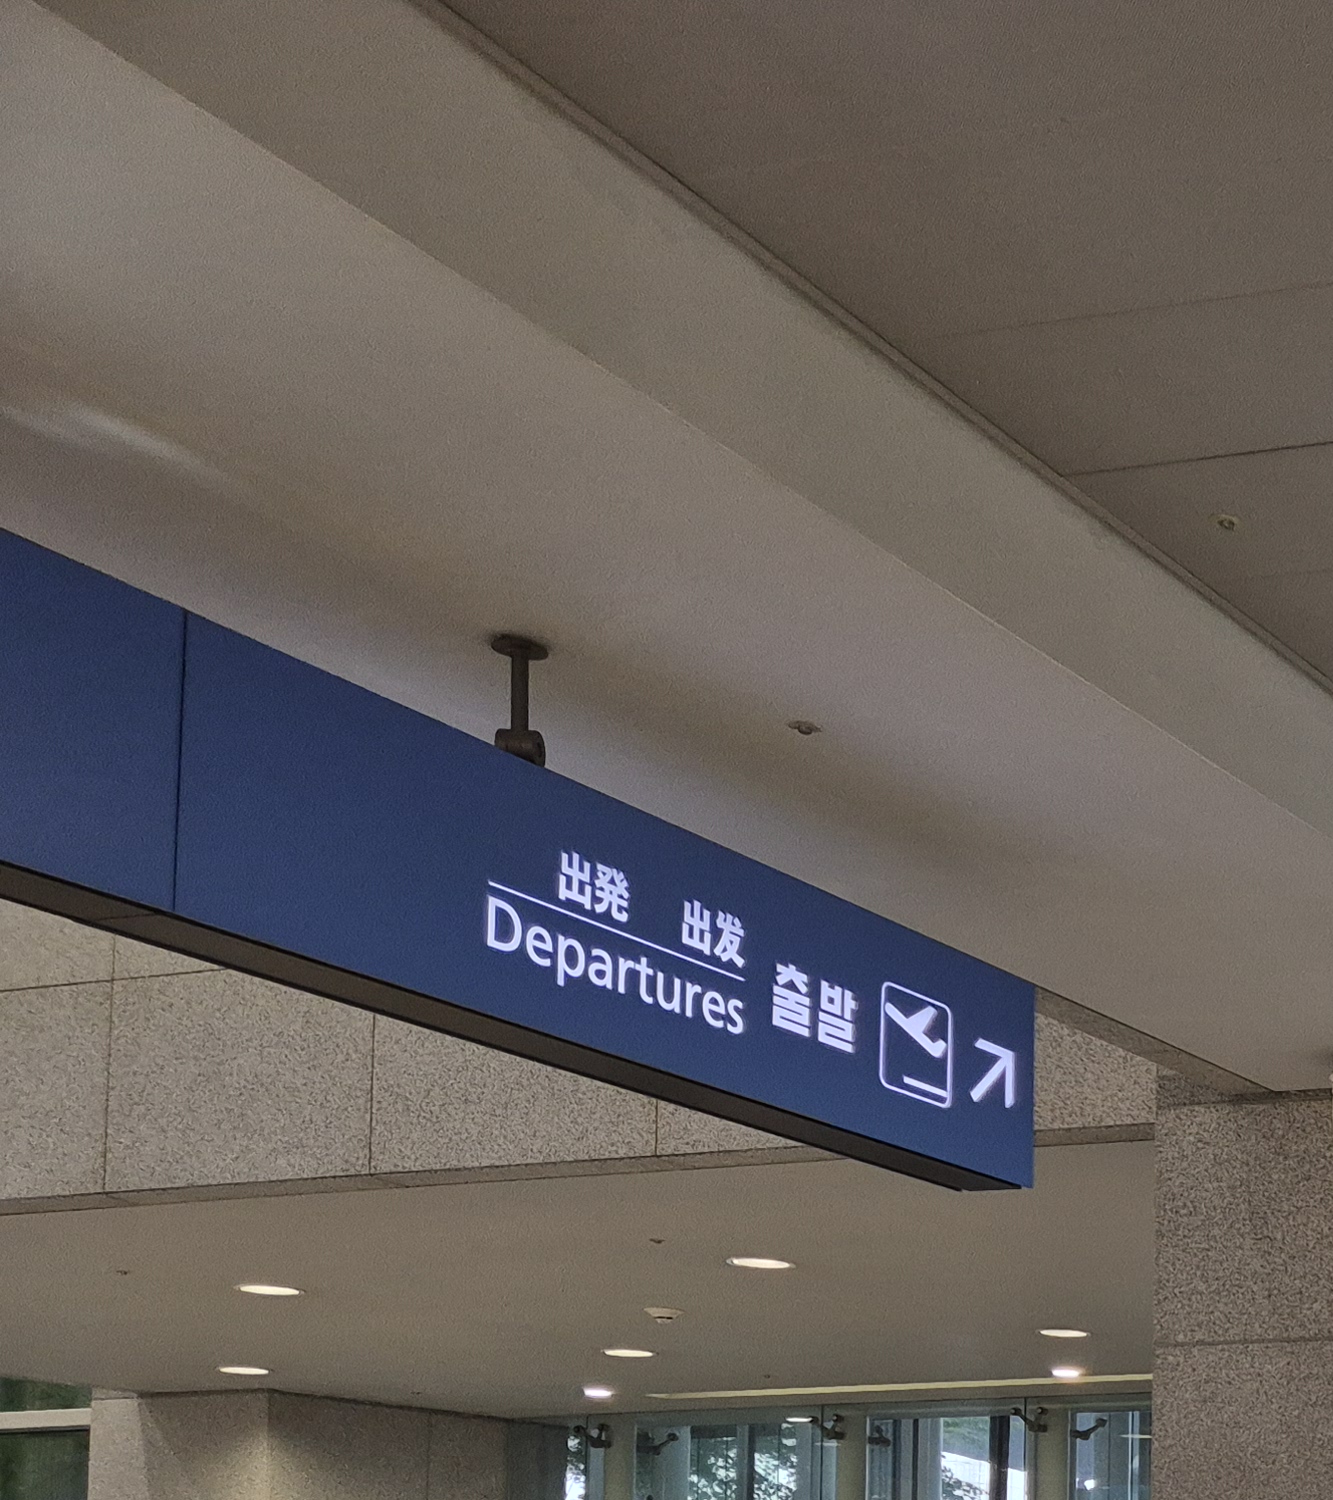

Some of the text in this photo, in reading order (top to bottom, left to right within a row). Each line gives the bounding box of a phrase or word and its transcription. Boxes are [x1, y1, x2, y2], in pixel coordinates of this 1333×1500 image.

[486, 894, 744, 1034] Departures
[558, 852, 746, 968] 出発 出发
[772, 963, 857, 1054] 출발
